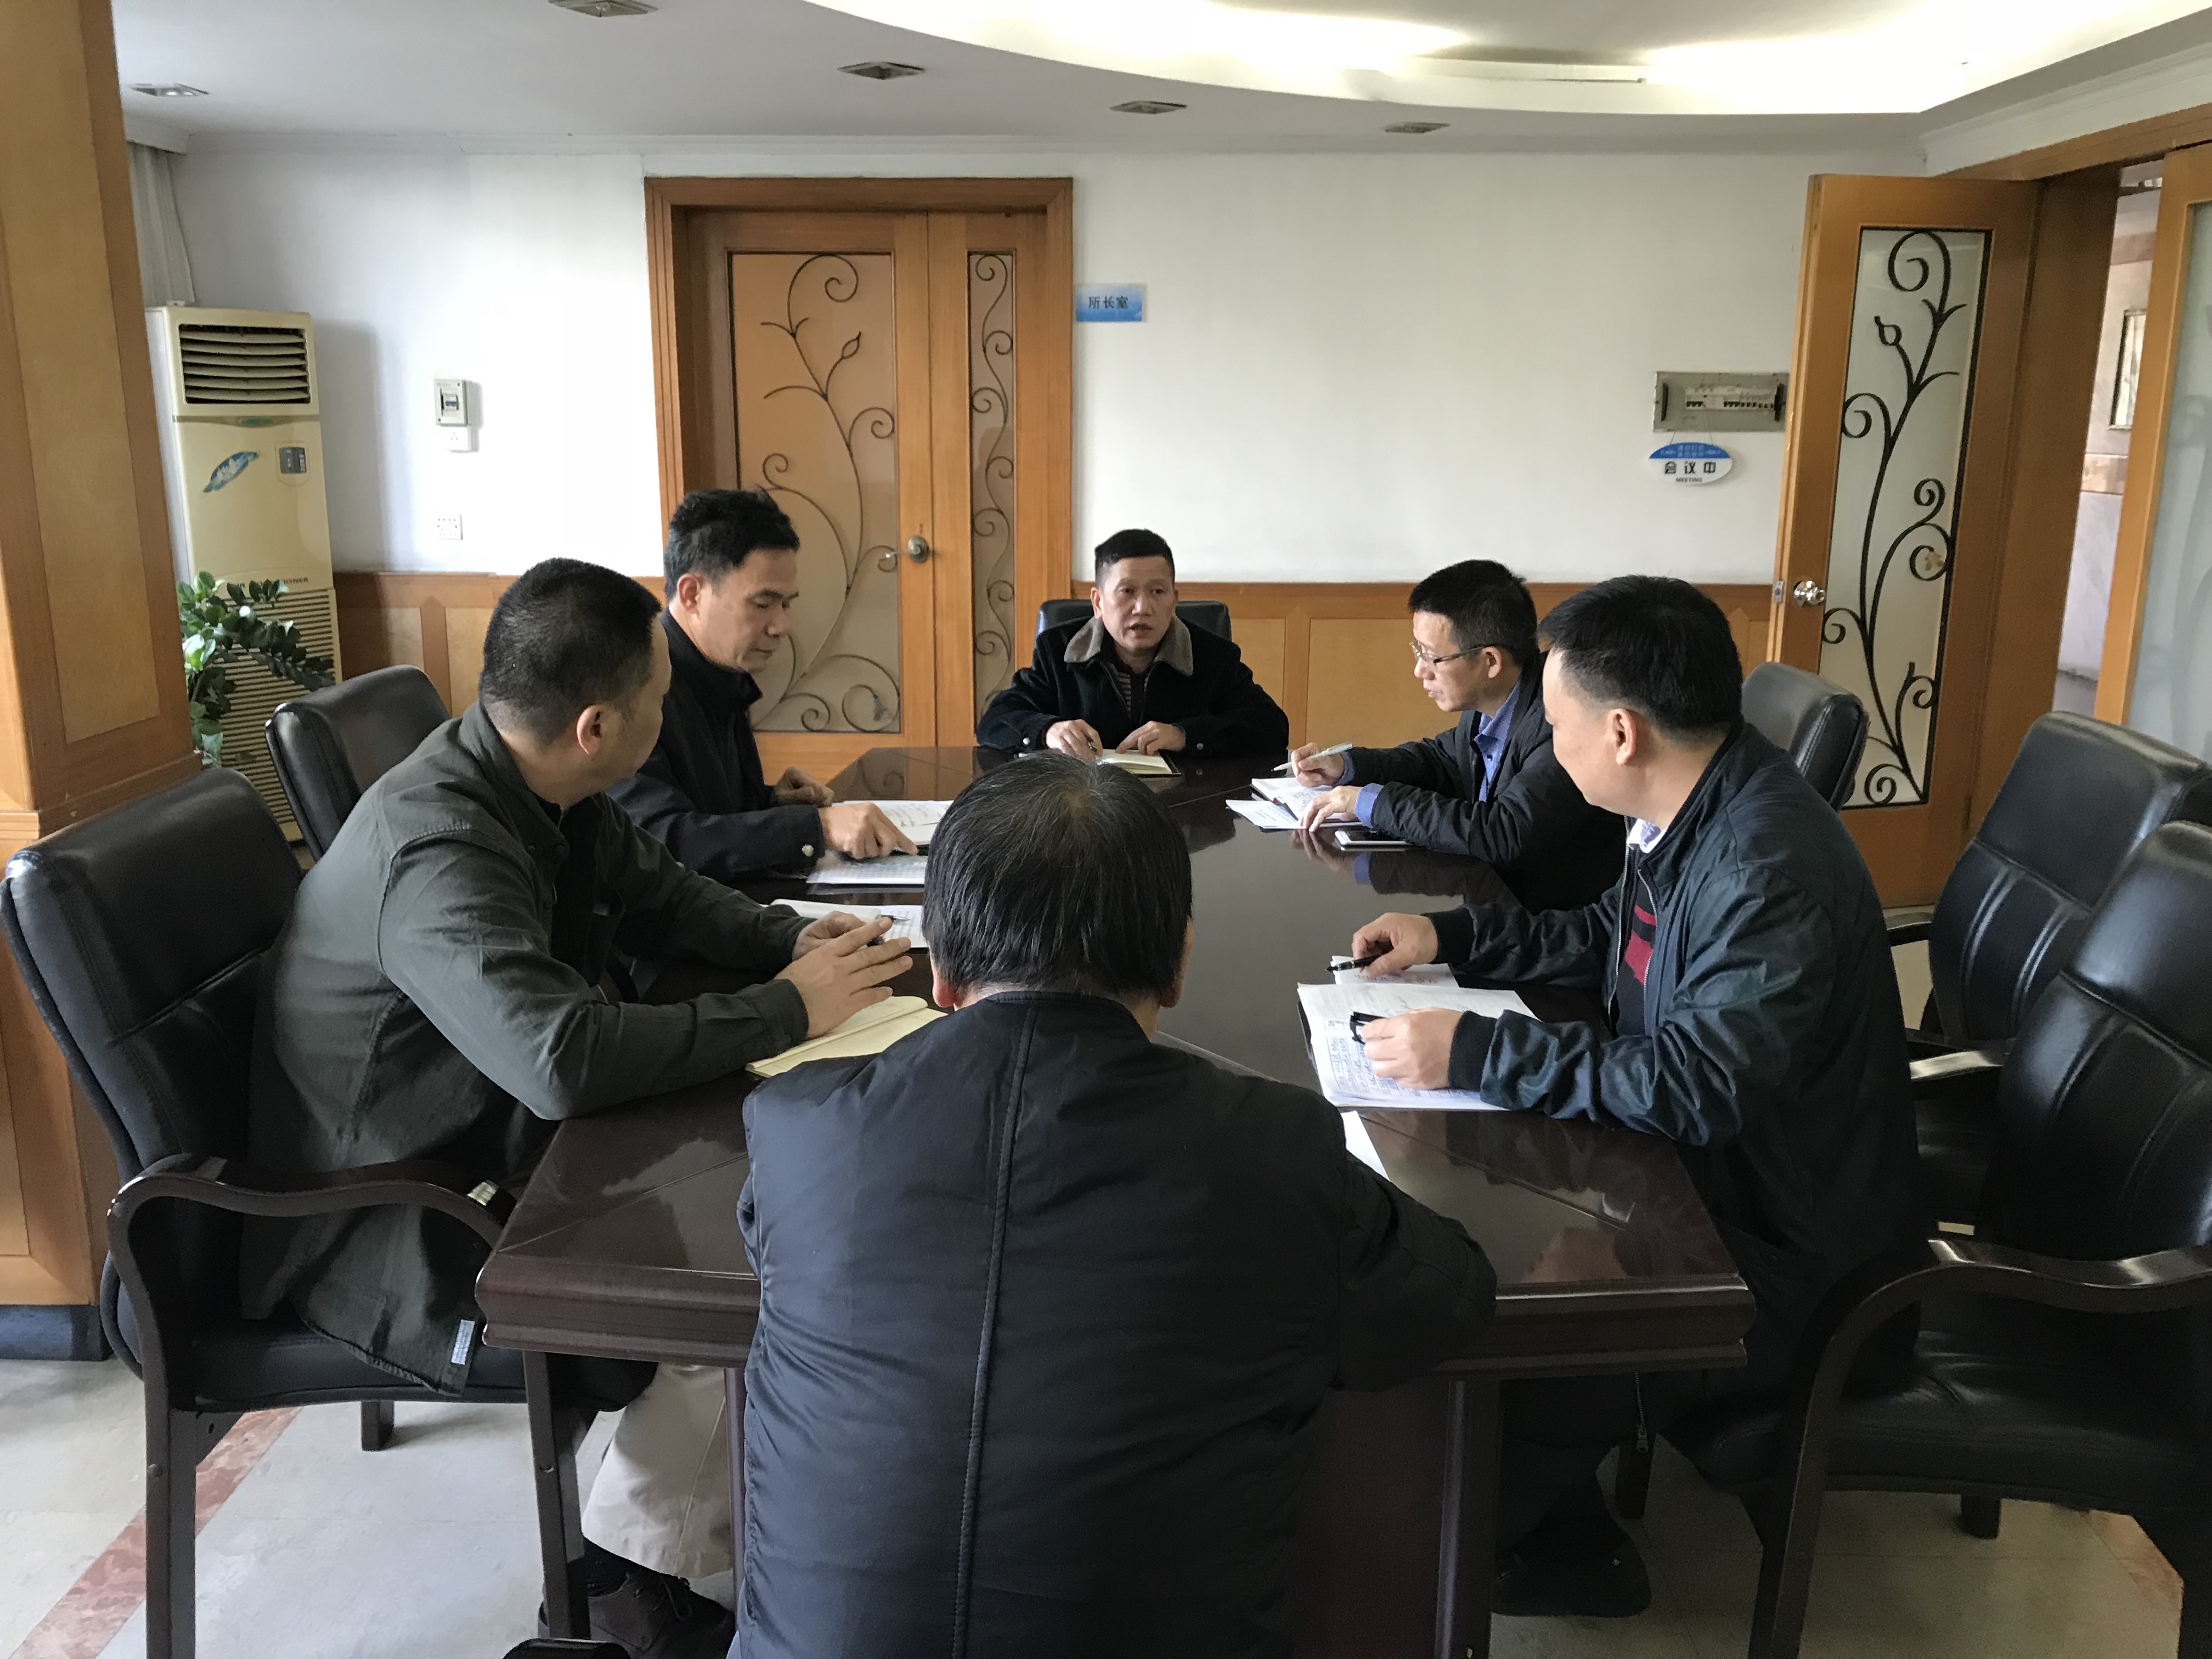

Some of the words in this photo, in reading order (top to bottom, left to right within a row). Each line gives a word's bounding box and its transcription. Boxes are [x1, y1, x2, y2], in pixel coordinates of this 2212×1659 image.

[1088, 295, 1128, 309] 所长室
[1664, 461, 1716, 474] 会议中
